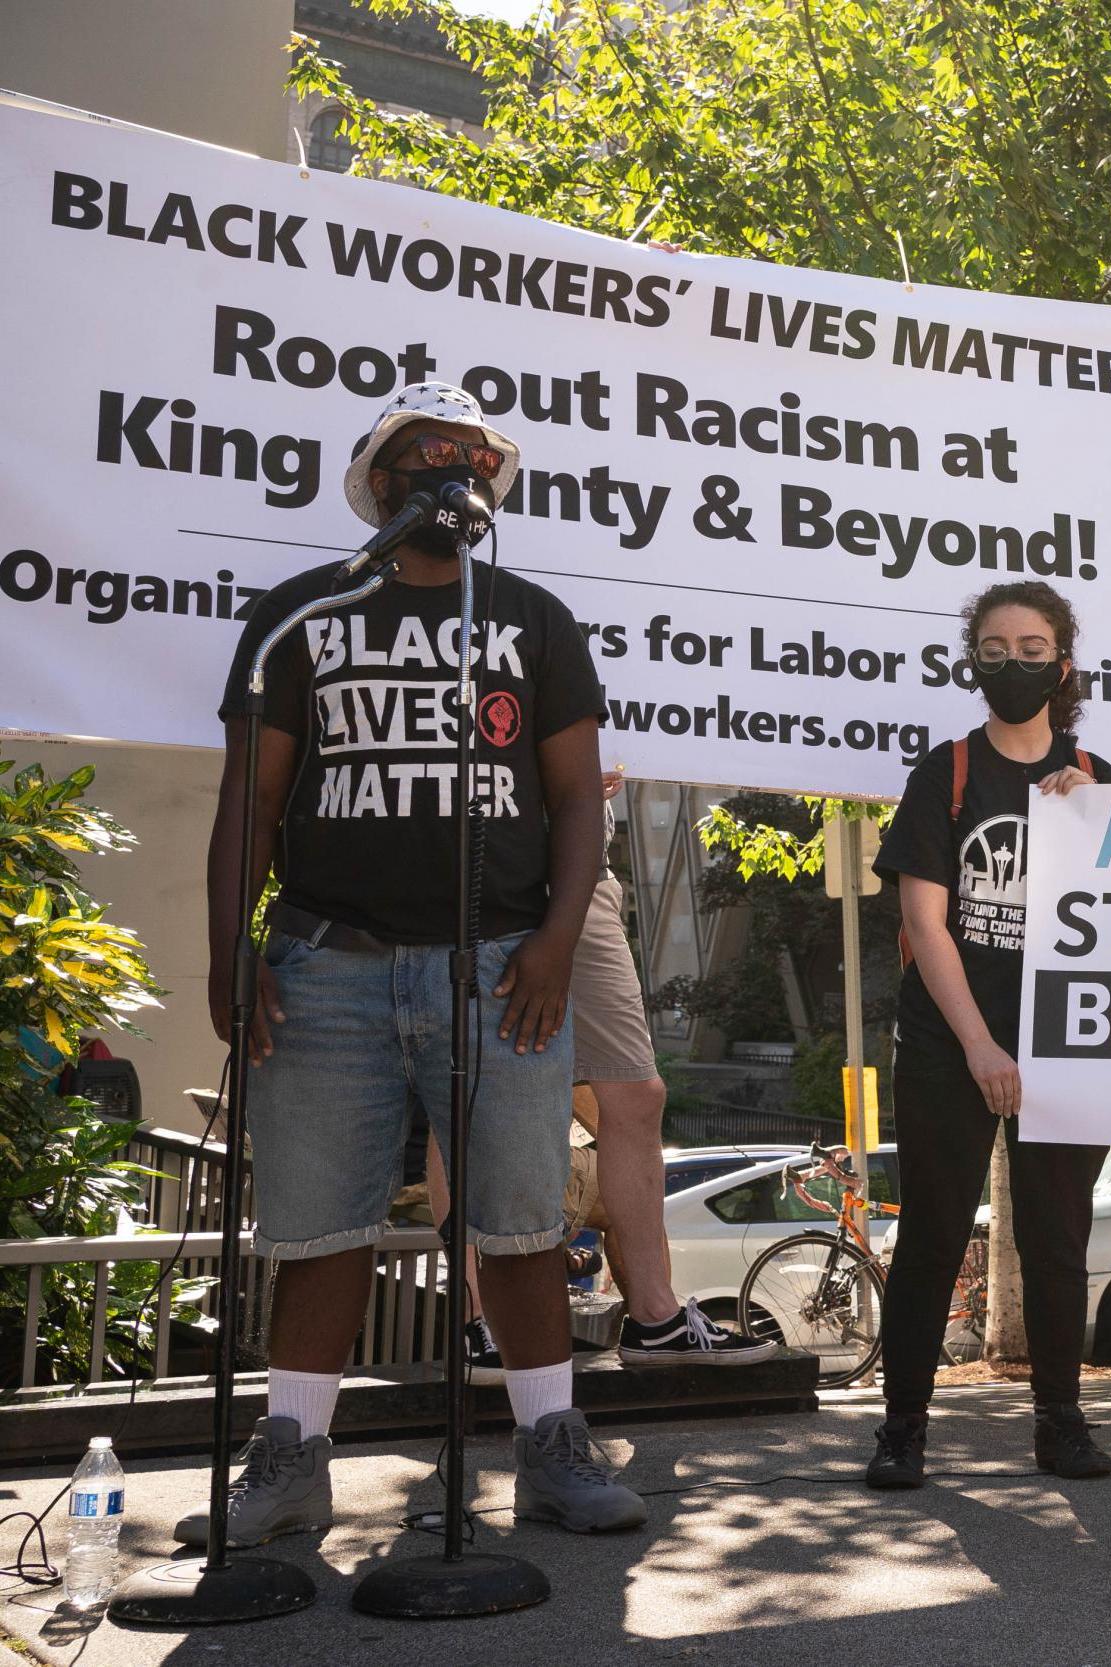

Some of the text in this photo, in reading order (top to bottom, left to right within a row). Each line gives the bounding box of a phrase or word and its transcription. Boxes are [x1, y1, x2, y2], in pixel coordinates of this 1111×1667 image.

[52, 170, 308, 270] BLACK
[710, 286, 876, 361] LIVES
[213, 304, 1018, 484] Root out Racism at
[96, 390, 321, 509] King
[692, 475, 757, 543] &
[781, 483, 1098, 580] Beyond!
[0, 549, 271, 624] Organiz
[644, 614, 733, 668] for
[750, 627, 906, 685] Labor
[305, 614, 524, 680] BLACK
[316, 685, 475, 748] LIVES
[598, 684, 930, 768] workers.org
[317, 764, 520, 818] MATTER
[959, 899, 1025, 921] DEFUND THE
[959, 913, 1025, 936] FUND COMM
[963, 929, 990, 946] FREE
